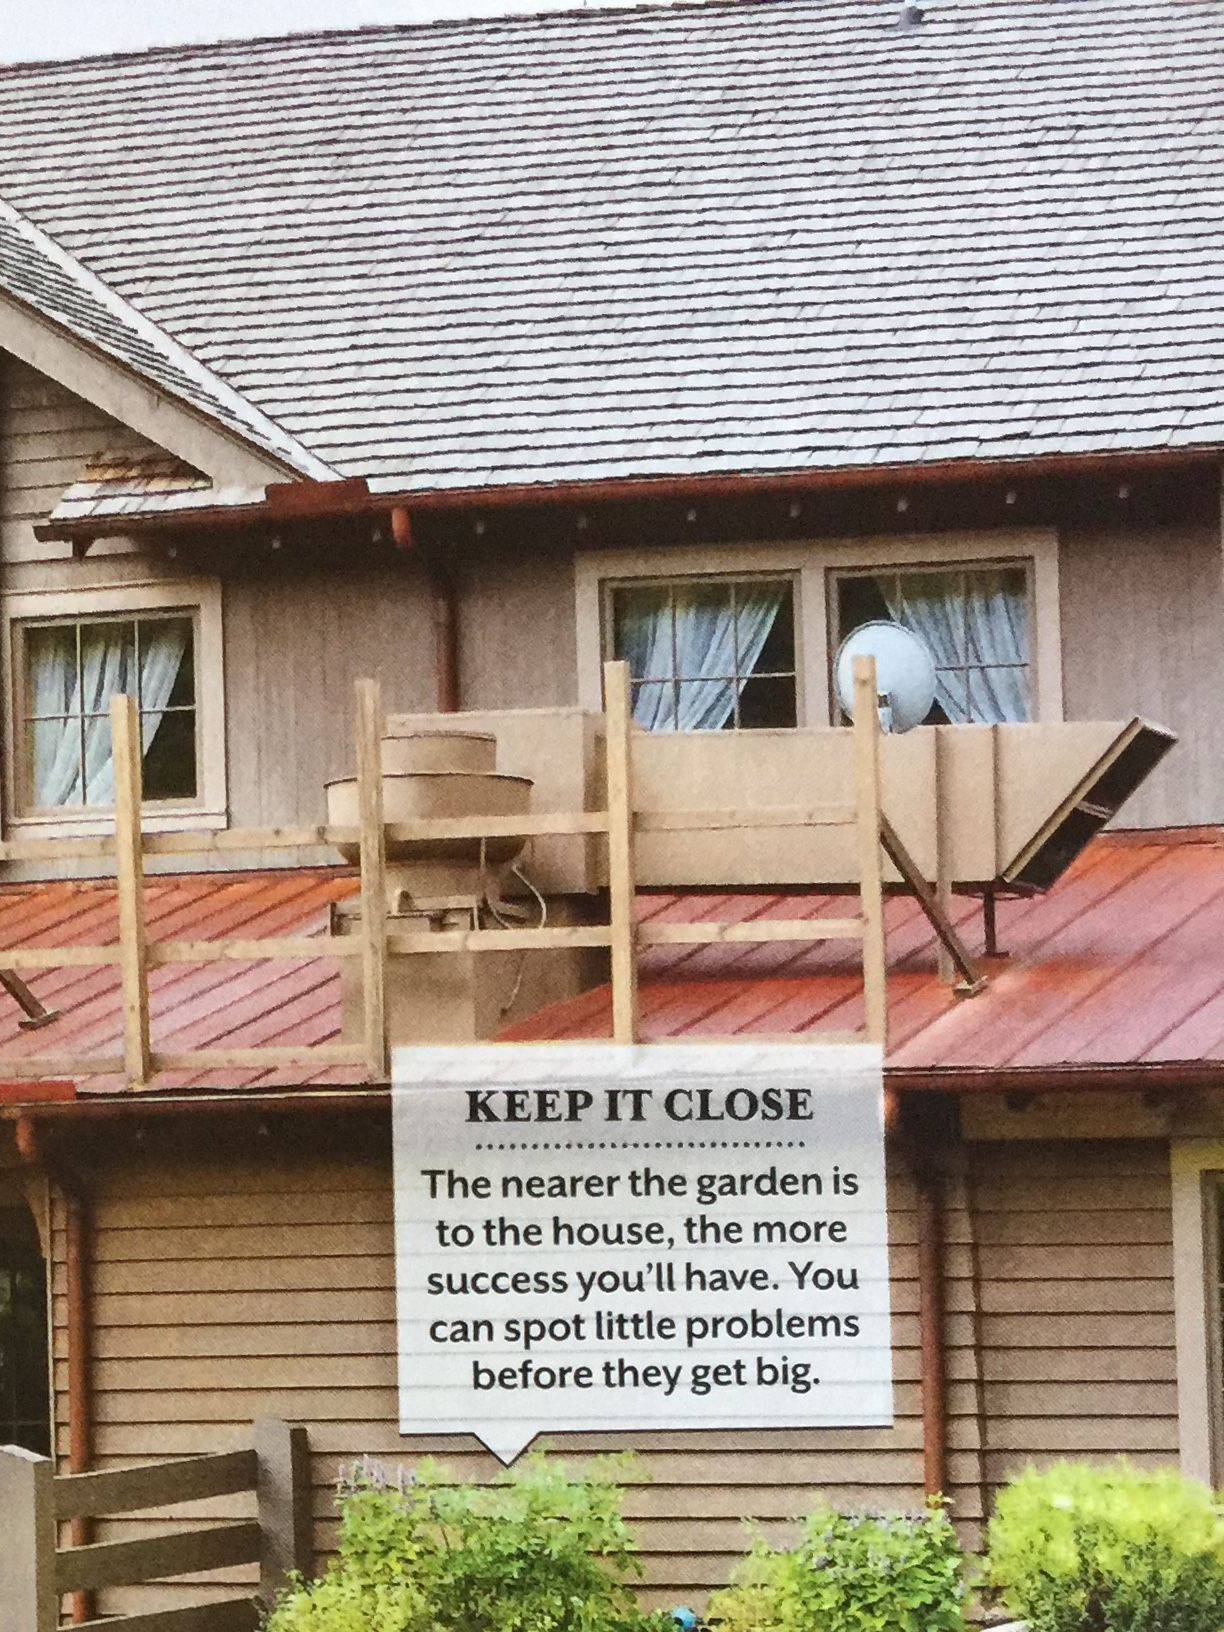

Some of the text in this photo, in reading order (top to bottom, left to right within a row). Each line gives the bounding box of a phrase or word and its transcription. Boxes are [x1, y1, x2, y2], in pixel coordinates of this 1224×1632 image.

[464, 1087, 814, 1123] KEEP IT CLOSE
[420, 1165, 859, 1206] The nearer the garden is
[435, 1214, 847, 1250] to the house, the more
[427, 1270, 569, 1296] success
[685, 1261, 779, 1292] have.
[787, 1260, 860, 1291] You
[429, 1307, 860, 1351] can spot little problems
[472, 1355, 821, 1397] before they get big.
